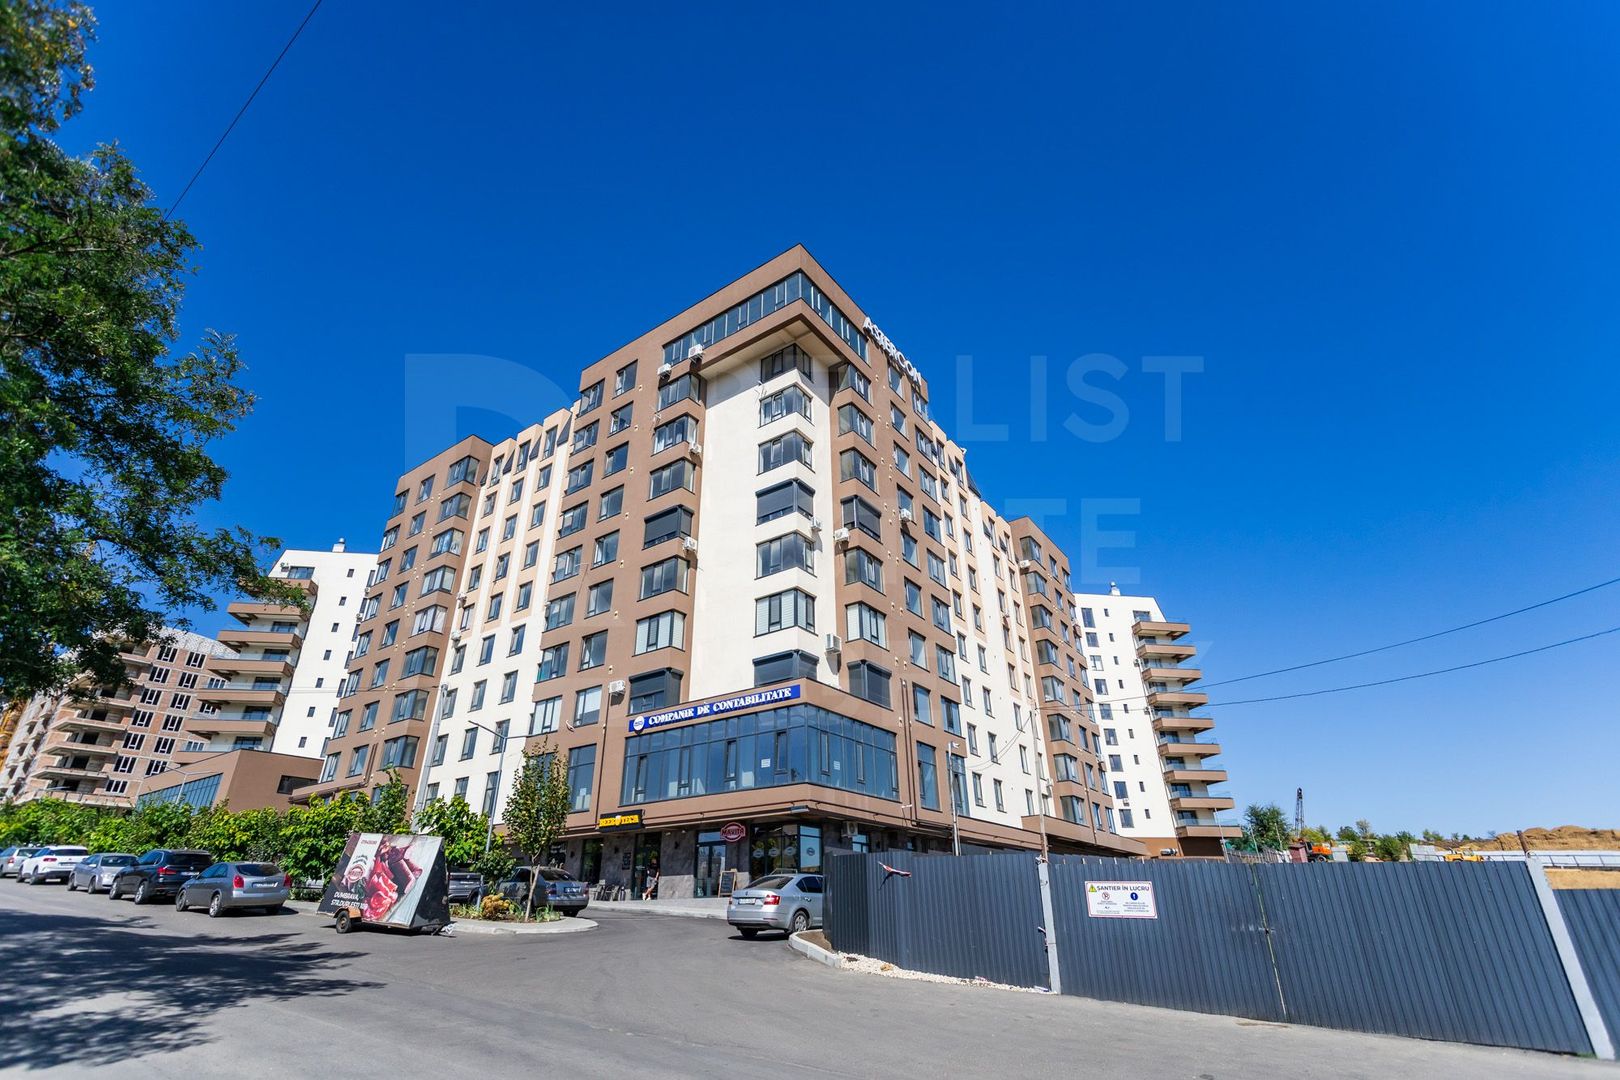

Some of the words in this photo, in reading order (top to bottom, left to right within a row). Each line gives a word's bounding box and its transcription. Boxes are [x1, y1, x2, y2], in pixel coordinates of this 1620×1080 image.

[648, 707, 694, 726] COMPANIE
[697, 704, 710, 715] DE
[712, 687, 792, 712] CONTABILITATE
